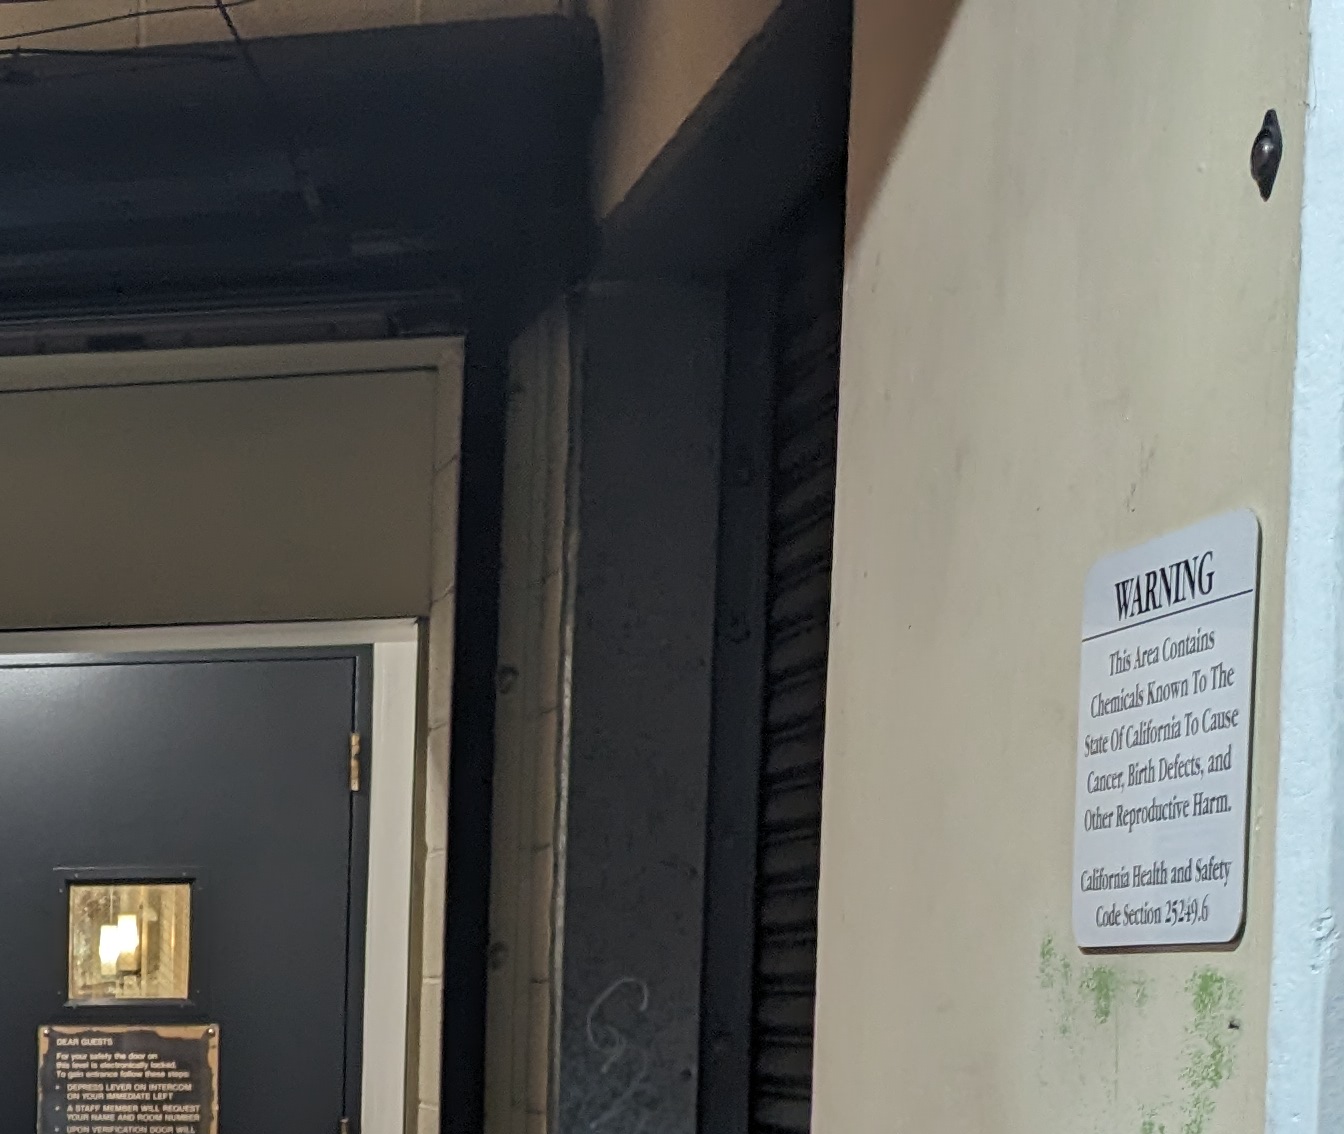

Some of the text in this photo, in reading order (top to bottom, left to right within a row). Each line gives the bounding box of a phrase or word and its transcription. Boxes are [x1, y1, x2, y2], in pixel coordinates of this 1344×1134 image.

[1114, 551, 1216, 621] WARNING
[1110, 627, 1215, 676] This Area Contains
[1091, 662, 1234, 718] Chemicals Known To The
[1085, 708, 1239, 757] State Of California To Cause
[1088, 744, 1232, 793] Cancer, Birth Defects, and
[1084, 792, 1232, 833] Other Reproductive Harm.
[1081, 856, 1232, 892] California Health and Safety
[1096, 894, 1209, 927] Code Section 25249.6
[68, 1071, 84, 1079] gain
[90, 1053, 112, 1061] safety
[100, 1062, 148, 1070] electronically
[150, 1126, 173, 1134] DOOR
[176, 1126, 195, 1134] WILL
